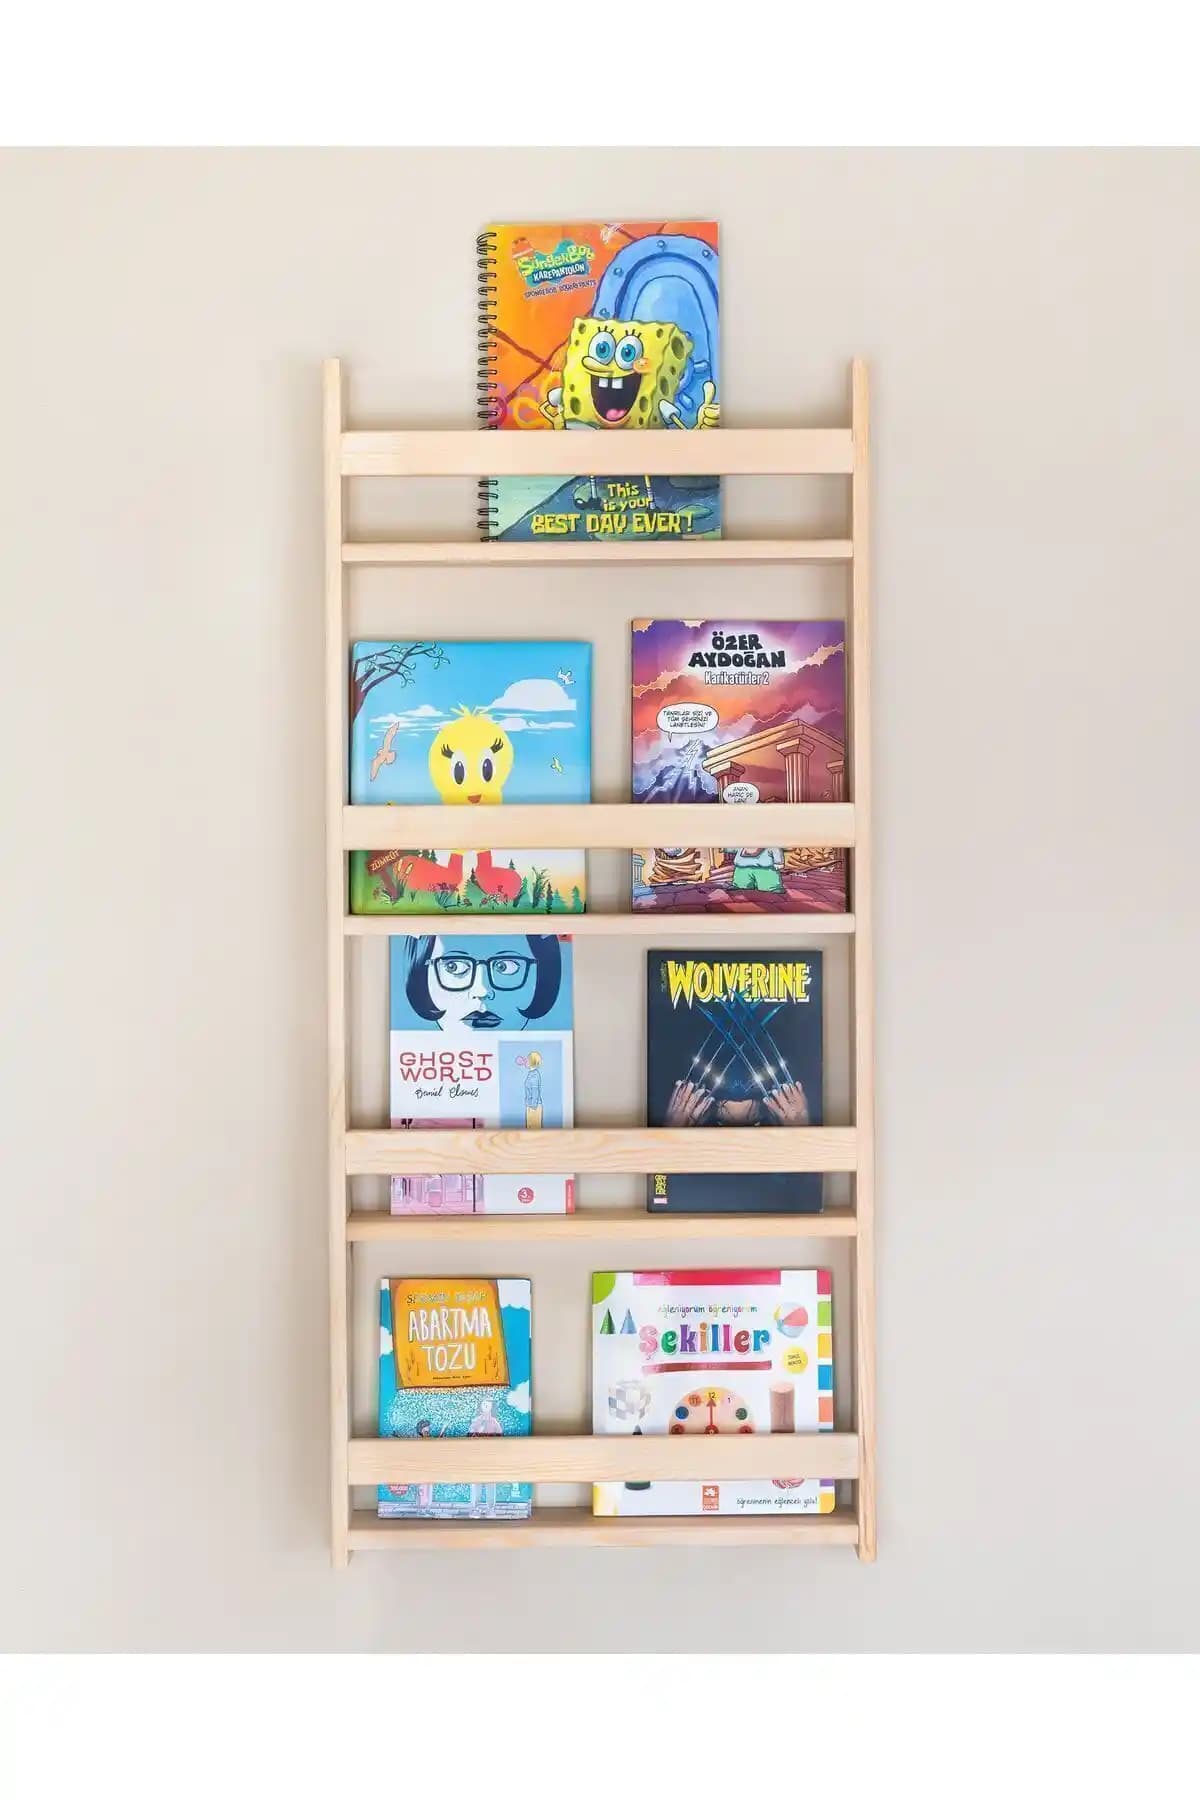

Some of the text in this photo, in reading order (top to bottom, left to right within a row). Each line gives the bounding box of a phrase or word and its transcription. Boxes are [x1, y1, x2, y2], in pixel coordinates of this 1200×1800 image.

[607, 482, 640, 498] This
[603, 496, 653, 512] is your
[531, 513, 581, 535] BEST
[586, 513, 628, 534] DAY
[711, 630, 763, 651] ÖZER
[687, 649, 786, 669] AYDOĞAN
[704, 671, 770, 686] Karikatürler 2
[667, 960, 811, 1009] WOLVERINE
[399, 1050, 494, 1068] GHOST
[399, 1067, 494, 1083] WORLD
[408, 1306, 493, 1343] ABARTMA
[638, 1321, 772, 1361] Şekiller
[421, 1342, 477, 1372] TOZU
